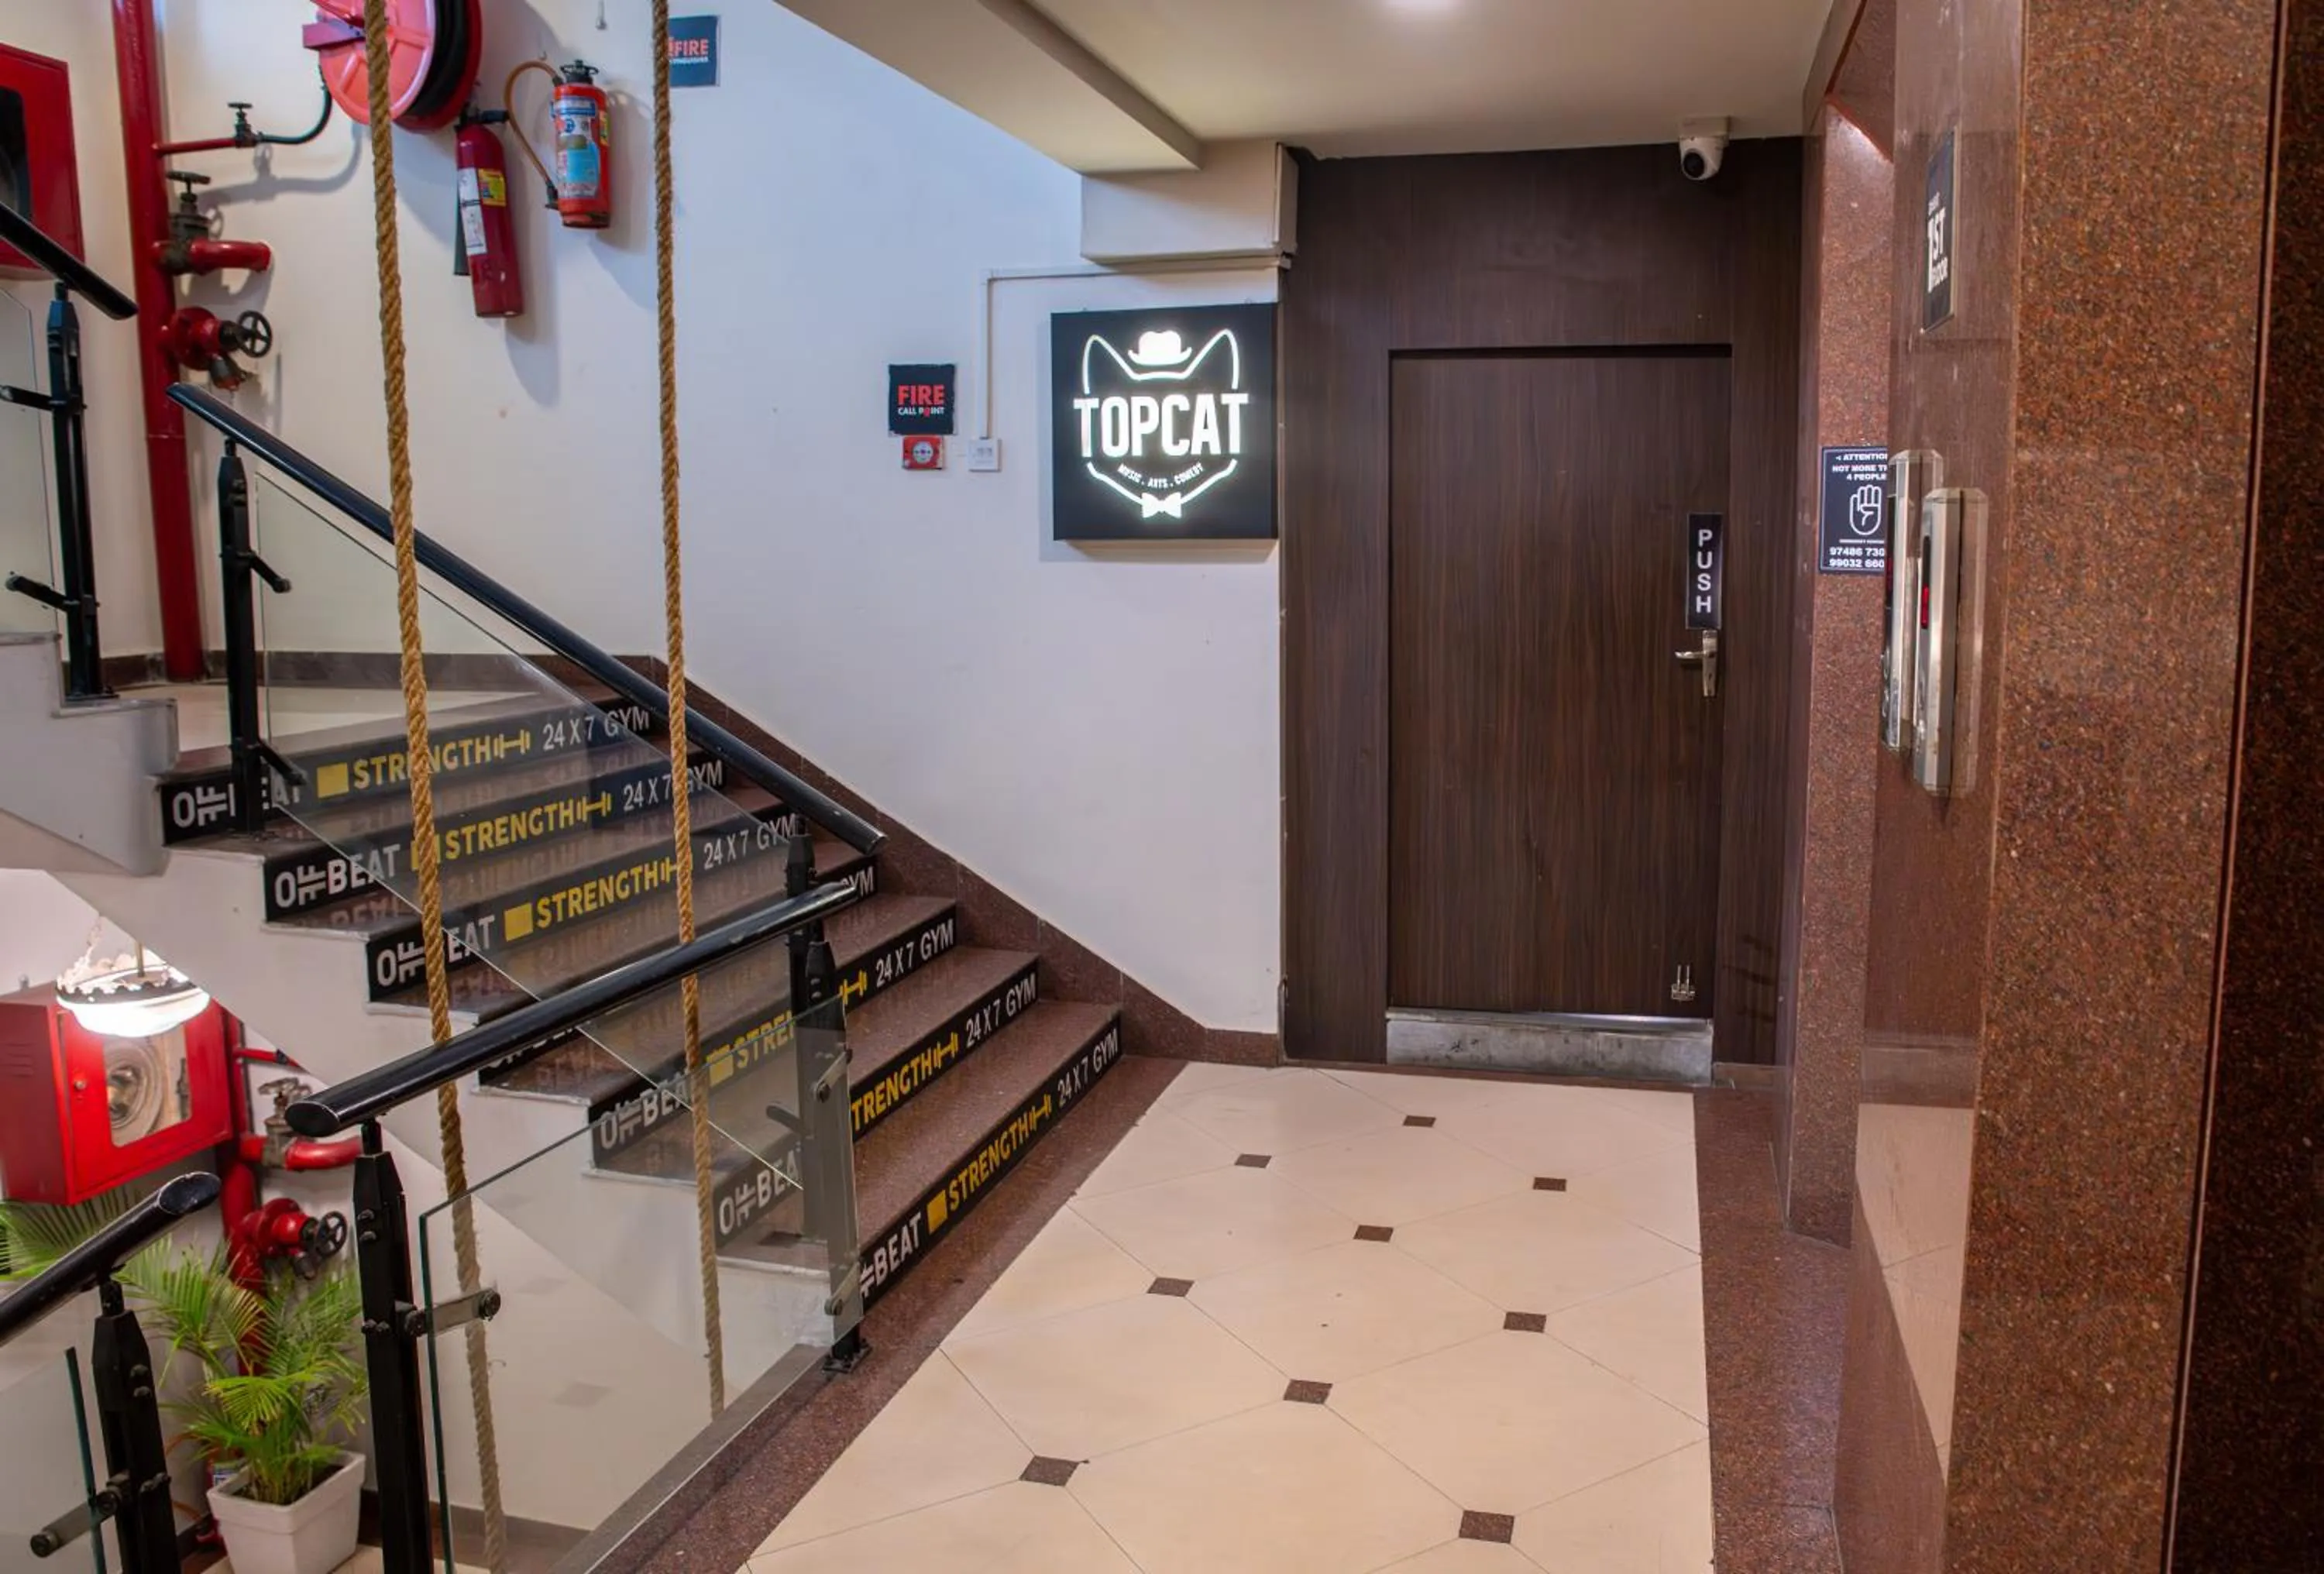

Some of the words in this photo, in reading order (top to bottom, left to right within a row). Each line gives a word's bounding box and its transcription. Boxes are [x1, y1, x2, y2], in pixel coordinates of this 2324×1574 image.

[675, 39, 709, 57] FIRE
[897, 384, 945, 405] FIRE
[898, 407, 917, 416] CALL
[1073, 394, 1250, 458] TOPCAT
[1117, 463, 1143, 484] MUSIC
[1147, 477, 1169, 489] ARTS
[1174, 461, 1204, 485] COMEDY
[1696, 529, 1713, 613] PUSH
[1865, 547, 1885, 557] 730
[353, 735, 493, 790] STRNGTH
[542, 720, 566, 752] 24
[569, 717, 581, 745] X
[585, 715, 596, 741] 7
[604, 705, 649, 737] GYM
[445, 798, 575, 861] STRENGTH
[623, 781, 644, 812] 24
[648, 777, 659, 805] X
[662, 773, 672, 800] 7
[376, 915, 496, 988] OFFEAT
[537, 861, 658, 929] STRENGTH
[703, 837, 724, 871] 24
[727, 833, 737, 862] X
[740, 829, 750, 857] 7
[756, 813, 796, 851] GYM
[841, 867, 874, 898] YM
[600, 1067, 690, 1150] OFFBEA
[734, 1009, 796, 1069] STRE
[875, 954, 893, 988] 24
[895, 947, 904, 977] X
[906, 941, 915, 969] 7
[920, 919, 954, 961] GYM
[719, 1141, 802, 1236] OFFBEA
[851, 1046, 932, 1132] TRENGTH
[965, 1012, 981, 1048] 24
[983, 1005, 992, 1036] X
[993, 998, 1001, 1026] 7
[1006, 973, 1037, 1018] GYM
[948, 1112, 1030, 1211] STRENGTH
[1057, 1072, 1072, 1108] 24
[1073, 1064, 1082, 1094] X
[1081, 1056, 1088, 1083] 7
[1092, 1028, 1119, 1074] GYM
